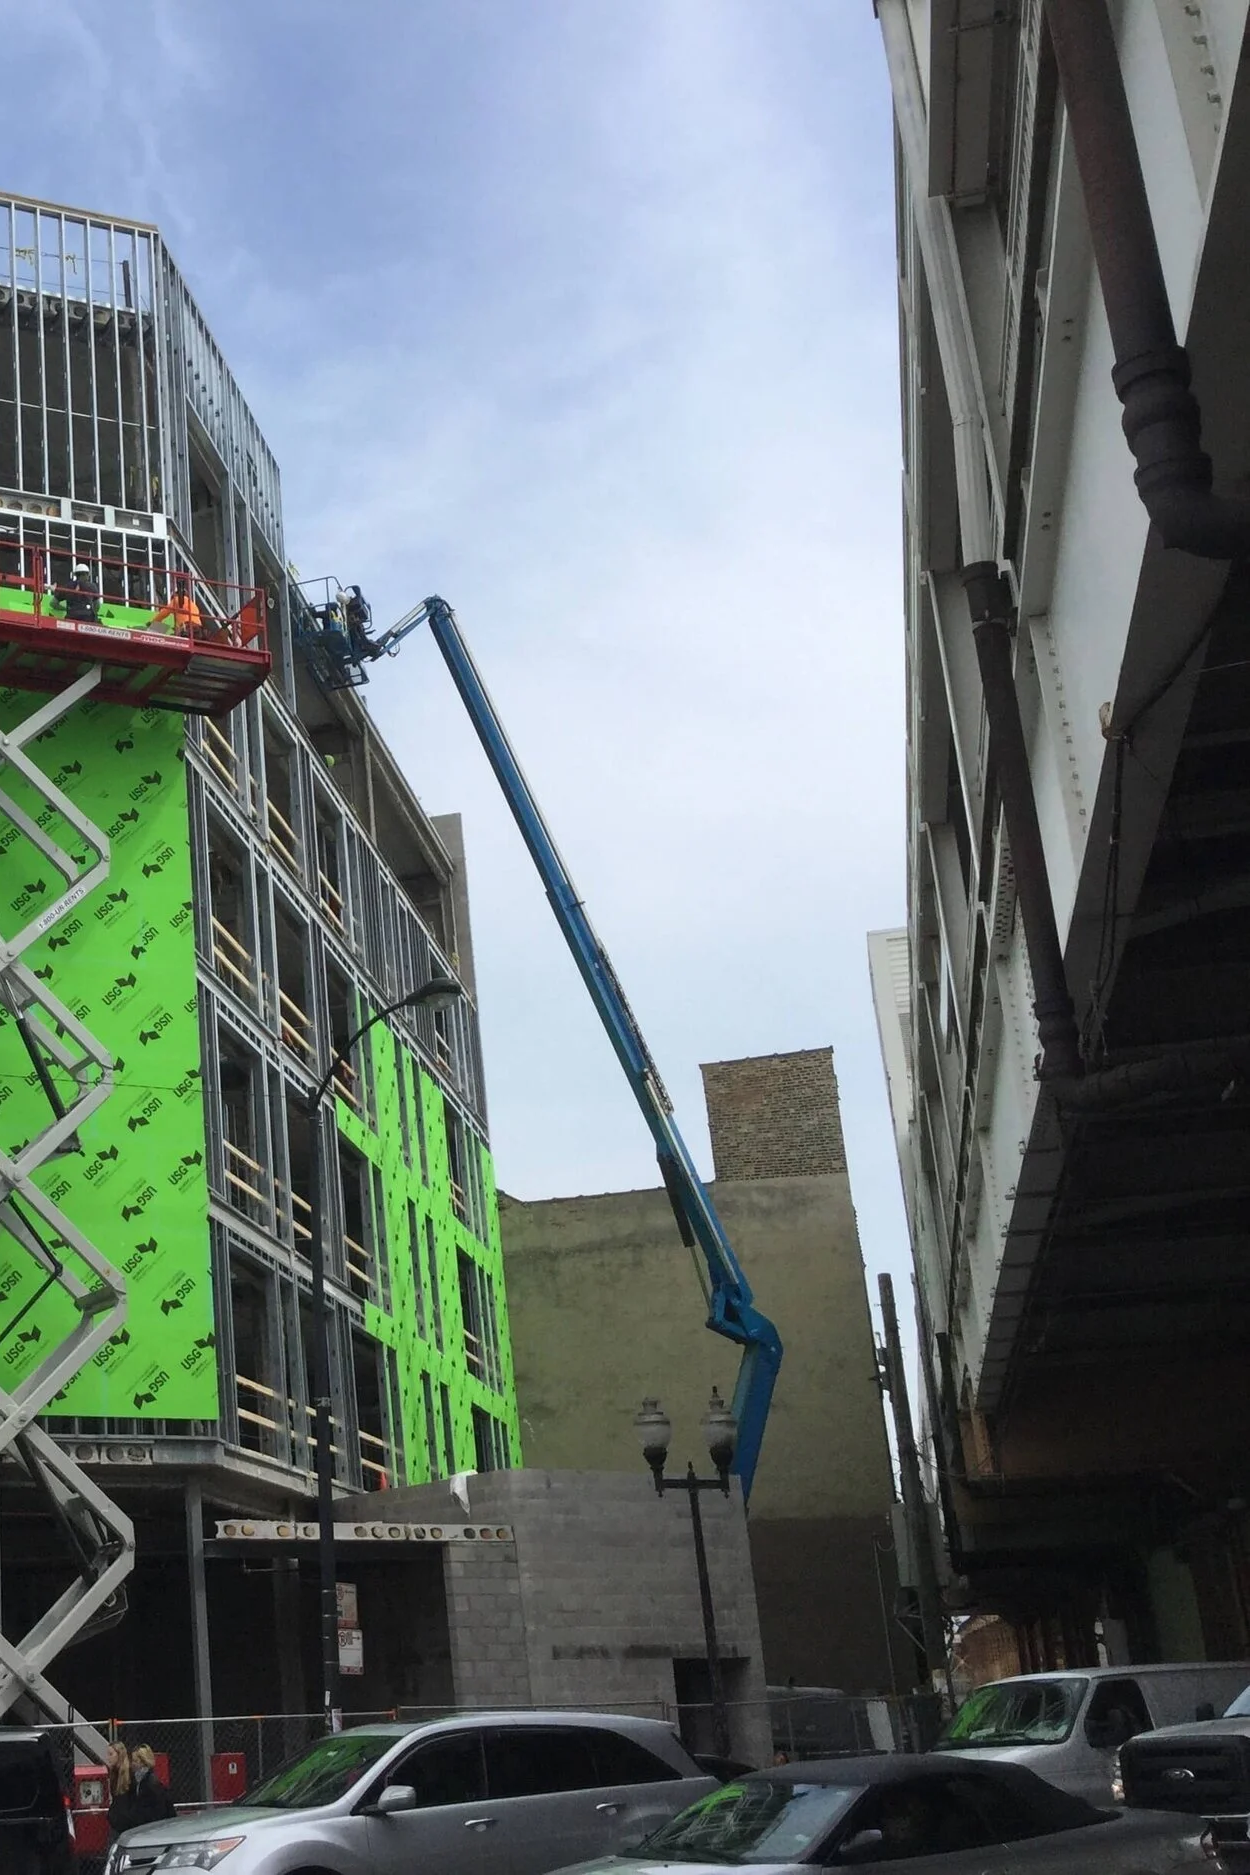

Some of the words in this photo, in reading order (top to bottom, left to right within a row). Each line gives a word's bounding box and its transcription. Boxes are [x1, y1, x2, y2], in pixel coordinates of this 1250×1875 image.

[129, 784, 149, 801] USG
[0, 829, 21, 847] USG
[106, 821, 125, 839] USG
[156, 847, 175, 865] USG
[11, 893, 30, 912] USG
[94, 902, 114, 920] USG
[63, 919, 83, 938] USG
[169, 910, 189, 929] USG
[102, 987, 122, 1006] USG
[154, 1013, 174, 1031] USG
[143, 1098, 163, 1117] USG
[83, 1160, 103, 1181] USG
[168, 1166, 188, 1185] USG
[138, 1186, 157, 1206] USG
[122, 1253, 142, 1273] USG
[1, 1270, 22, 1291] USG
[176, 1279, 196, 1299] USG
[3, 1343, 25, 1365] USG
[93, 1346, 114, 1367] USG
[181, 1349, 201, 1370] USG
[149, 1371, 170, 1393] USG
